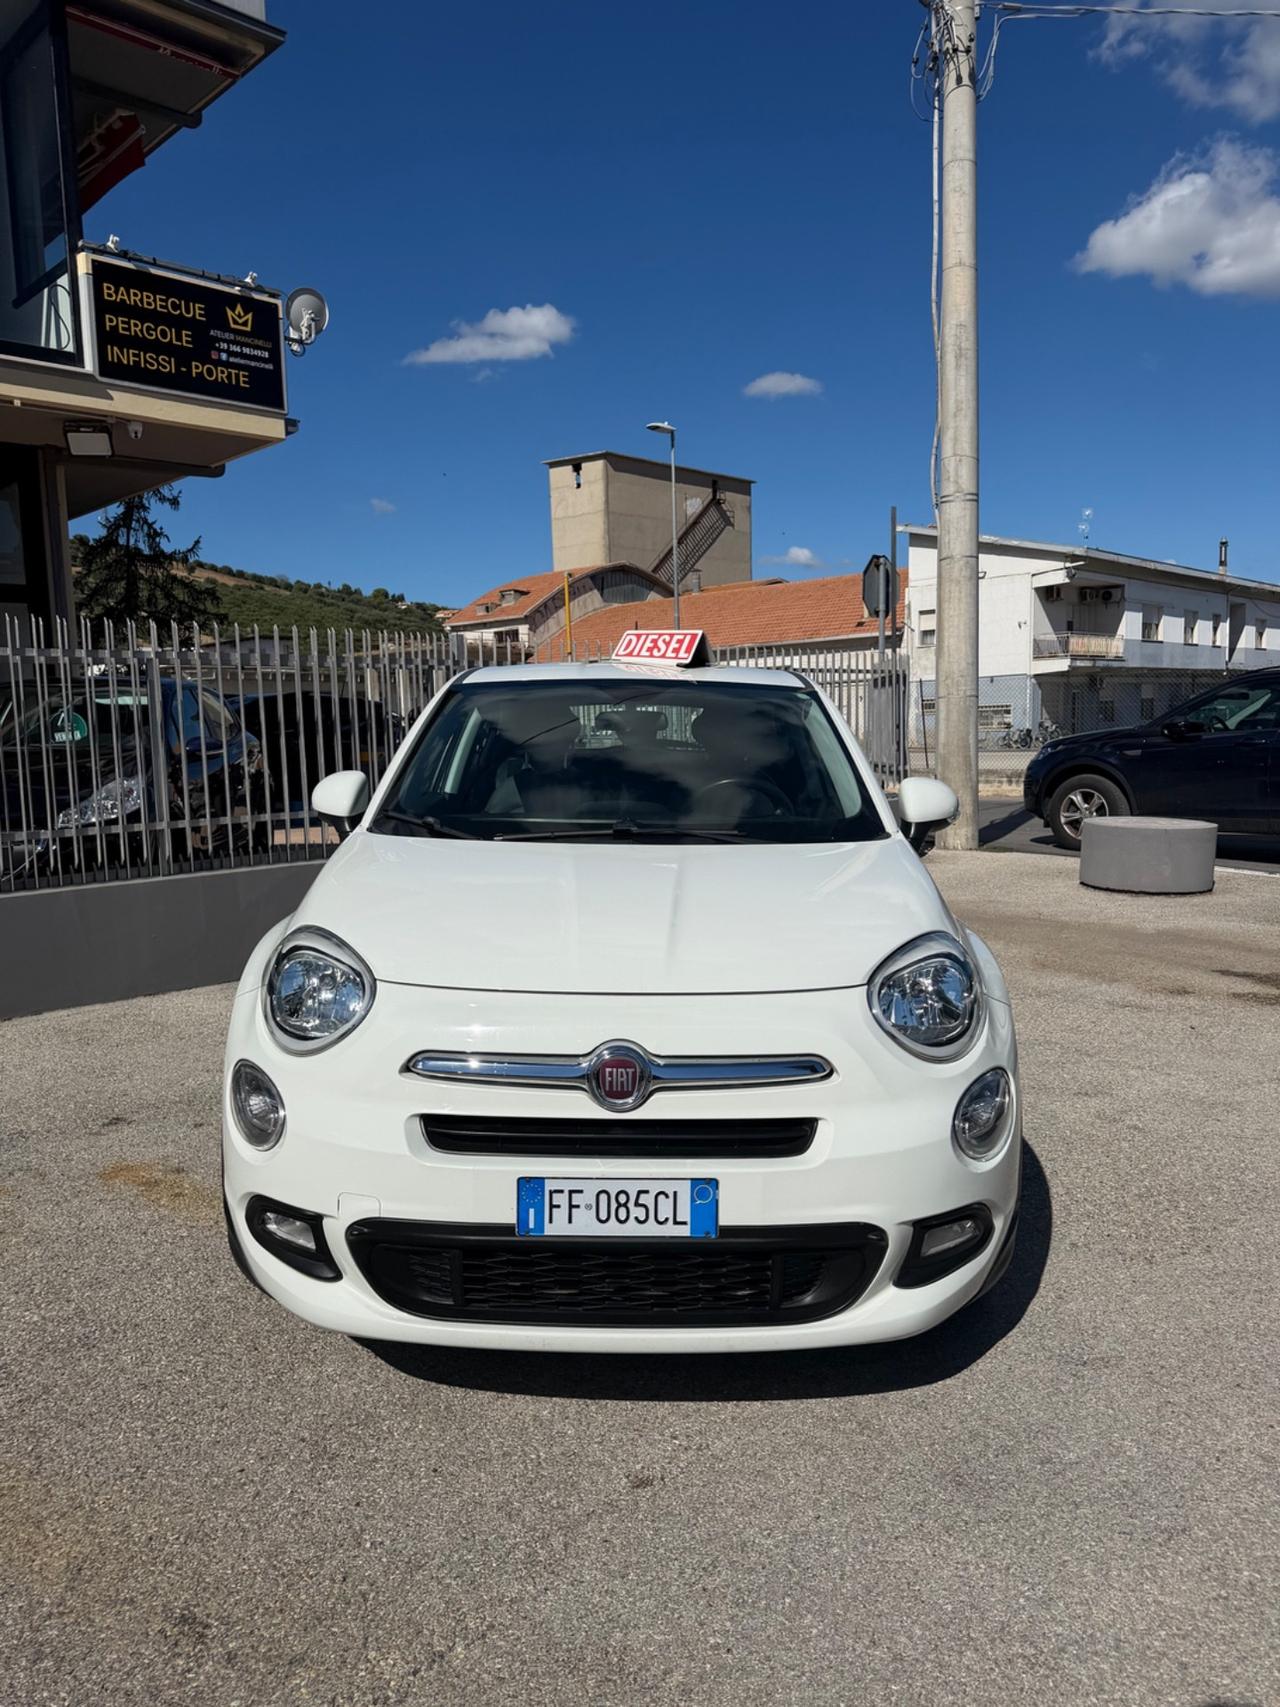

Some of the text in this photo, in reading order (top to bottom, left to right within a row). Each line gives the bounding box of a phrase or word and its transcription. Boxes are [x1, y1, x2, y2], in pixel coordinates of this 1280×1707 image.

[102, 282, 207, 321] BARBECUE
[104, 314, 193, 348] PERGOLE
[209, 329, 234, 341] ATELIER
[215, 341, 228, 350] +39
[229, 343, 241, 353] 366
[106, 345, 176, 374] INFISSI
[191, 361, 250, 388] PORTE
[617, 634, 691, 658] DIESEL
[604, 1067, 635, 1092] FIAT
